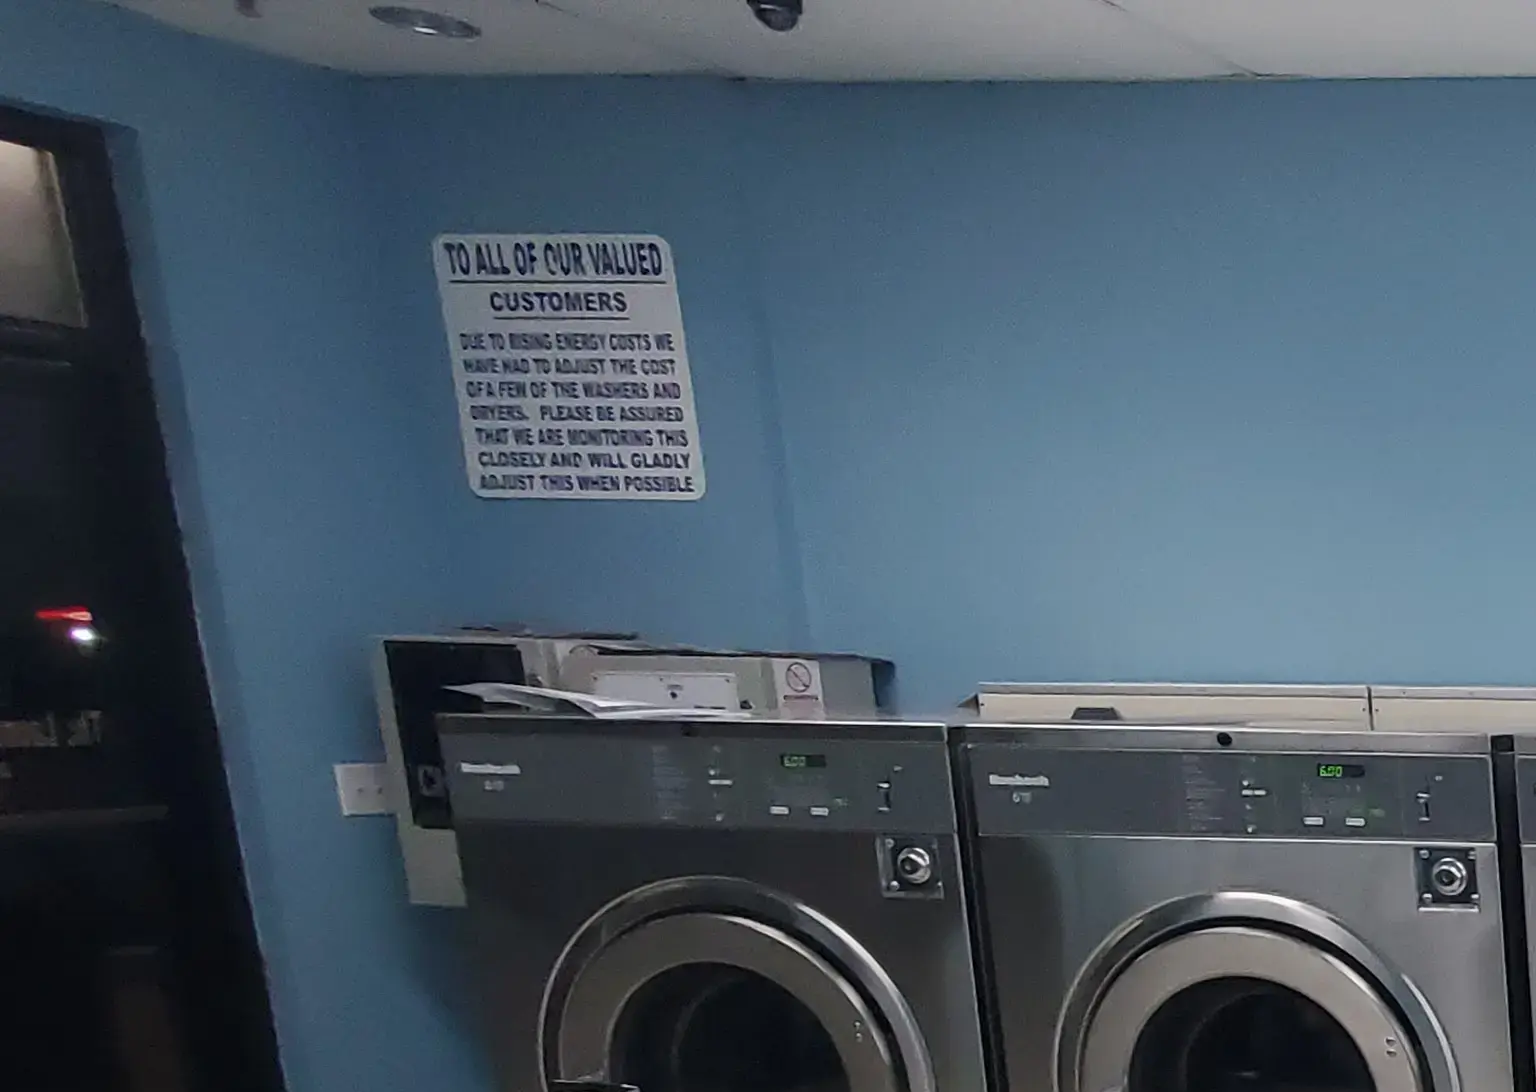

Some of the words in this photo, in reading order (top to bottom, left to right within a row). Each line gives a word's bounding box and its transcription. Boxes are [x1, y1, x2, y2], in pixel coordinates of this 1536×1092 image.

[443, 242, 470, 275] TO
[475, 243, 511, 275] ALL
[513, 242, 537, 276] OF
[544, 242, 587, 276] OUR
[587, 242, 662, 276] VALUED
[490, 291, 627, 312] CUSTOMERS
[459, 333, 485, 350] DUE
[488, 333, 505, 350] TO
[508, 333, 552, 350] RISING
[555, 333, 606, 351] ENERGY
[609, 333, 651, 351] COSTS
[653, 333, 675, 351] WE
[463, 358, 499, 373] HAVE
[501, 358, 530, 374] HAD
[532, 358, 551, 374] TO
[555, 358, 606, 375] ADJUST
[609, 358, 638, 375] THE
[640, 359, 676, 375] COST
[466, 381, 484, 398] OF
[486, 381, 497, 397] A
[498, 381, 527, 398] FEW
[530, 381, 547, 398] OF
[550, 381, 580, 398] THE
[582, 382, 649, 399] WASHERS
[653, 382, 681, 399] AND
[470, 405, 530, 421] DRYERS.
[540, 405, 593, 421] PLEASE
[596, 406, 615, 421] BE
[620, 406, 684, 422] ASSURED
[475, 427, 508, 445] THAT
[512, 428, 534, 446] WE
[538, 428, 564, 446] ARE
[567, 428, 653, 446] MONITORING
[656, 429, 688, 447] THIS
[478, 451, 545, 467] CLOSELY
[550, 452, 582, 468] AND
[587, 452, 628, 468] WILL
[631, 452, 690, 469] GLADLY
[479, 474, 534, 491] ADJUST
[539, 475, 574, 491] THIS
[576, 475, 620, 491] WHEN
[623, 475, 695, 492] POSSIBLE
